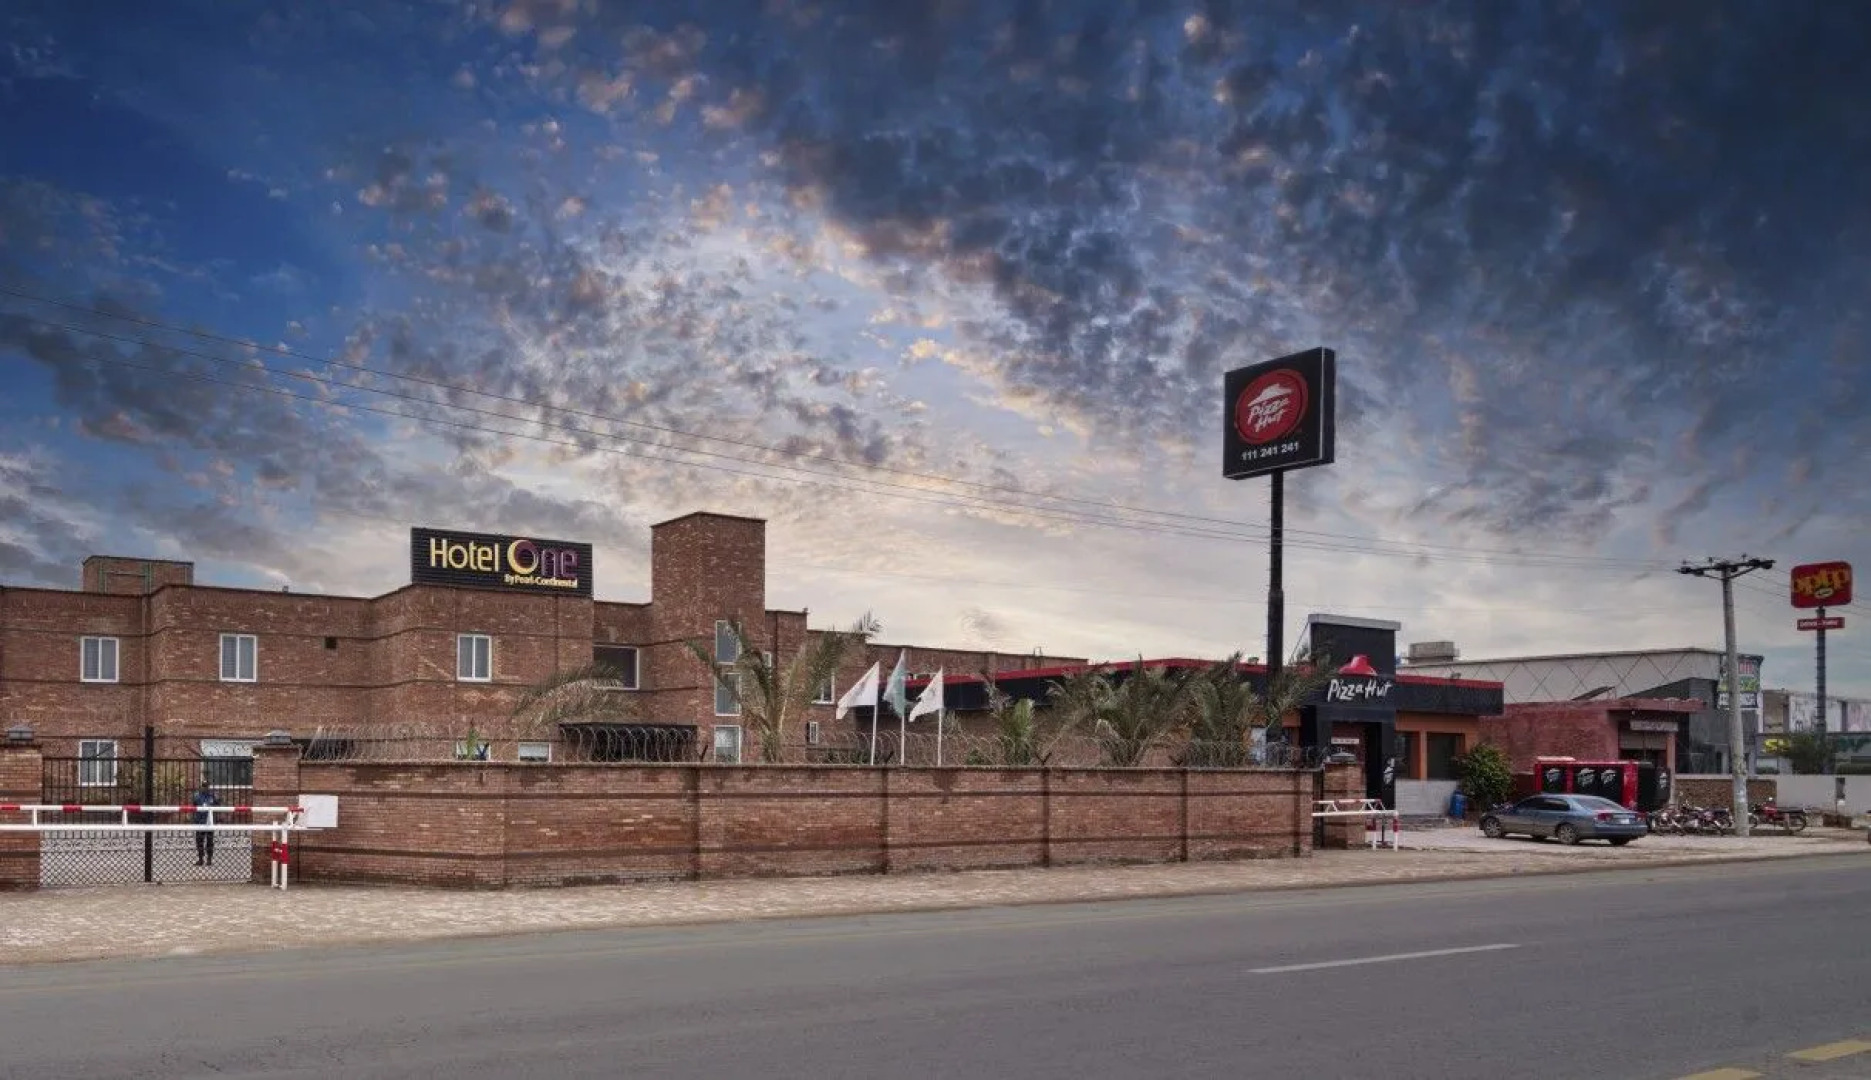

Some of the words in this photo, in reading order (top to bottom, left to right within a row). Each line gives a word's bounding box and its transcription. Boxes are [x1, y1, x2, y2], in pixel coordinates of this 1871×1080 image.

[1247, 398, 1289, 425] Pizza
[1254, 409, 1286, 432] Hut
[1241, 450, 1257, 461] 111
[1260, 446, 1278, 458] 241
[1281, 441, 1299, 453] 241
[430, 537, 499, 572] Hotel
[507, 539, 578, 577] One
[1327, 679, 1363, 702] Pizza
[1364, 679, 1393, 699] Hut
